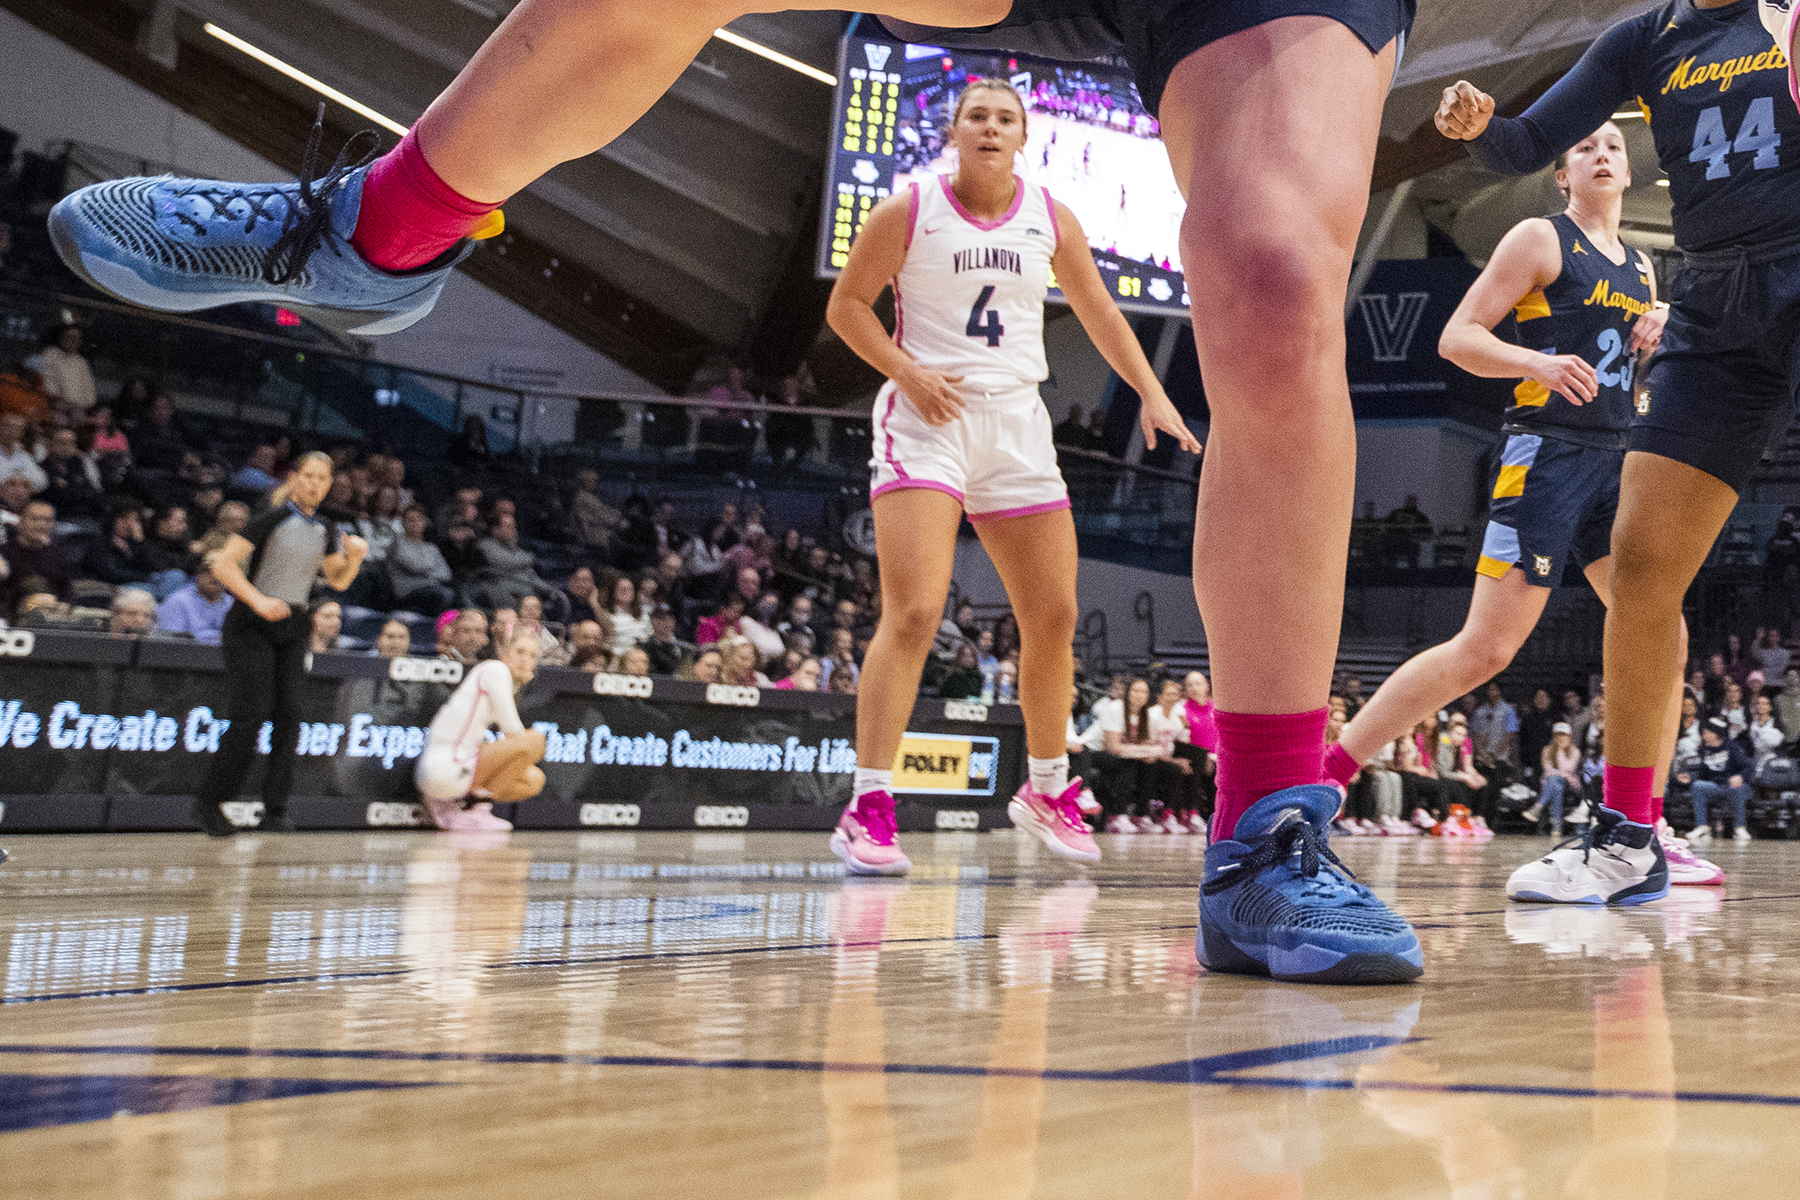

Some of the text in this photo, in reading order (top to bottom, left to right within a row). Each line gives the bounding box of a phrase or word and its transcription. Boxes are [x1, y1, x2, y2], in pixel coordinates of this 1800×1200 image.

[1688, 96, 1781, 181] 44
[954, 248, 1022, 276] VILLANOVA
[1117, 275, 1141, 298] 51
[966, 285, 1004, 347] 4
[390, 656, 464, 684] GEICO
[593, 672, 653, 698] GEICO
[48, 700, 179, 752] Create
[533, 721, 588, 763] That
[590, 724, 669, 766] Create
[671, 729, 783, 771] Customers
[783, 736, 819, 773] For
[818, 737, 858, 773] Life
